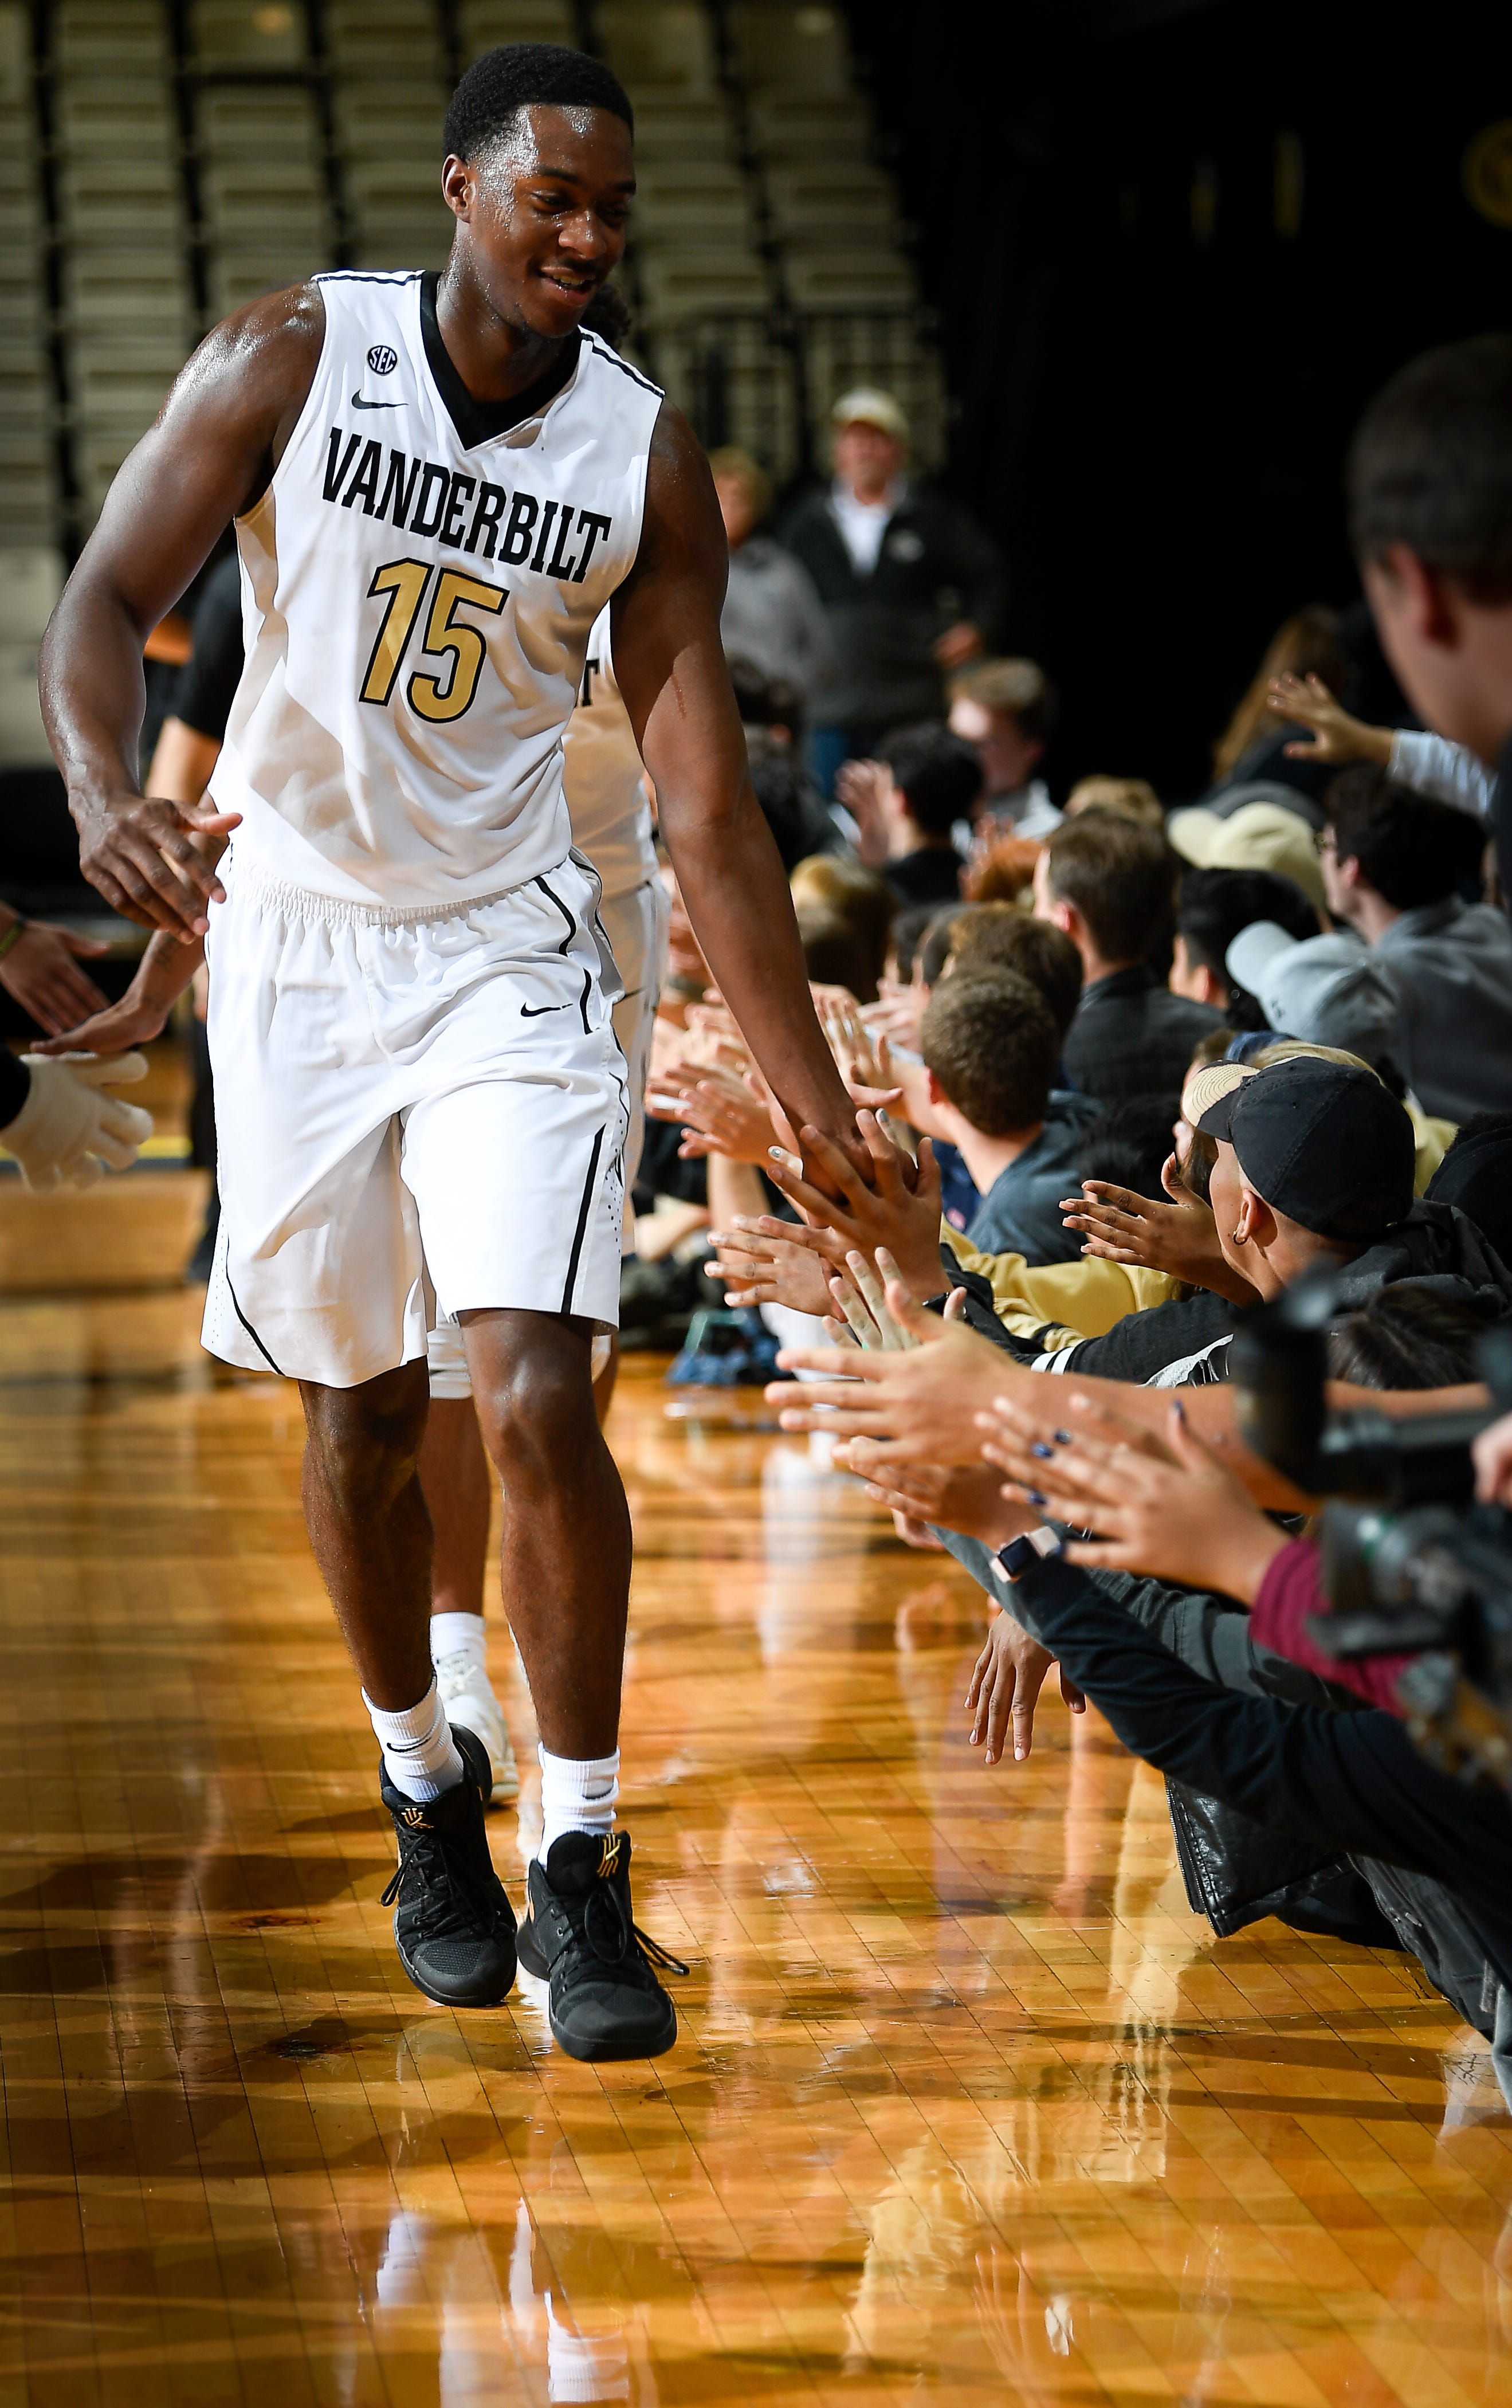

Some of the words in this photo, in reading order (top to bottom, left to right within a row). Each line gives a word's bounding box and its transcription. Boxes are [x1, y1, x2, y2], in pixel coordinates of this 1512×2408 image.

[368, 346, 396, 374] SEC
[322, 428, 611, 583] VANDERBILT
[359, 557, 509, 723] 15
